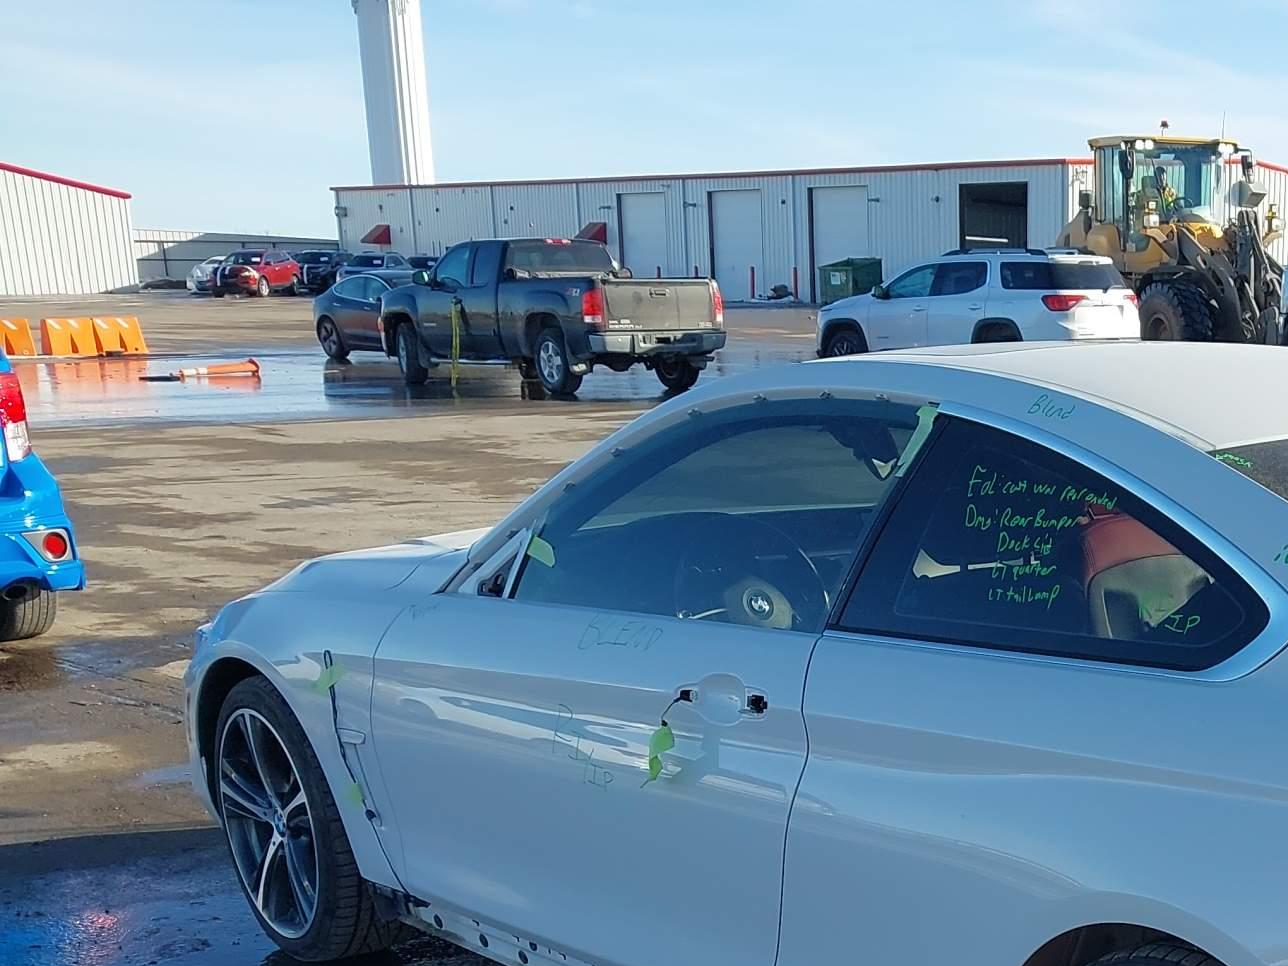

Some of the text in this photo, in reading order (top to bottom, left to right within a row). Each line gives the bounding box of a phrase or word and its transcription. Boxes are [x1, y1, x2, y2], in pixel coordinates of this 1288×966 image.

[1000, 508, 1032, 528] Rear
[1034, 508, 1080, 531] Bumper
[997, 531, 1030, 552] Deck
[1012, 564, 1057, 580] quarter
[1164, 615, 1201, 635] IP
